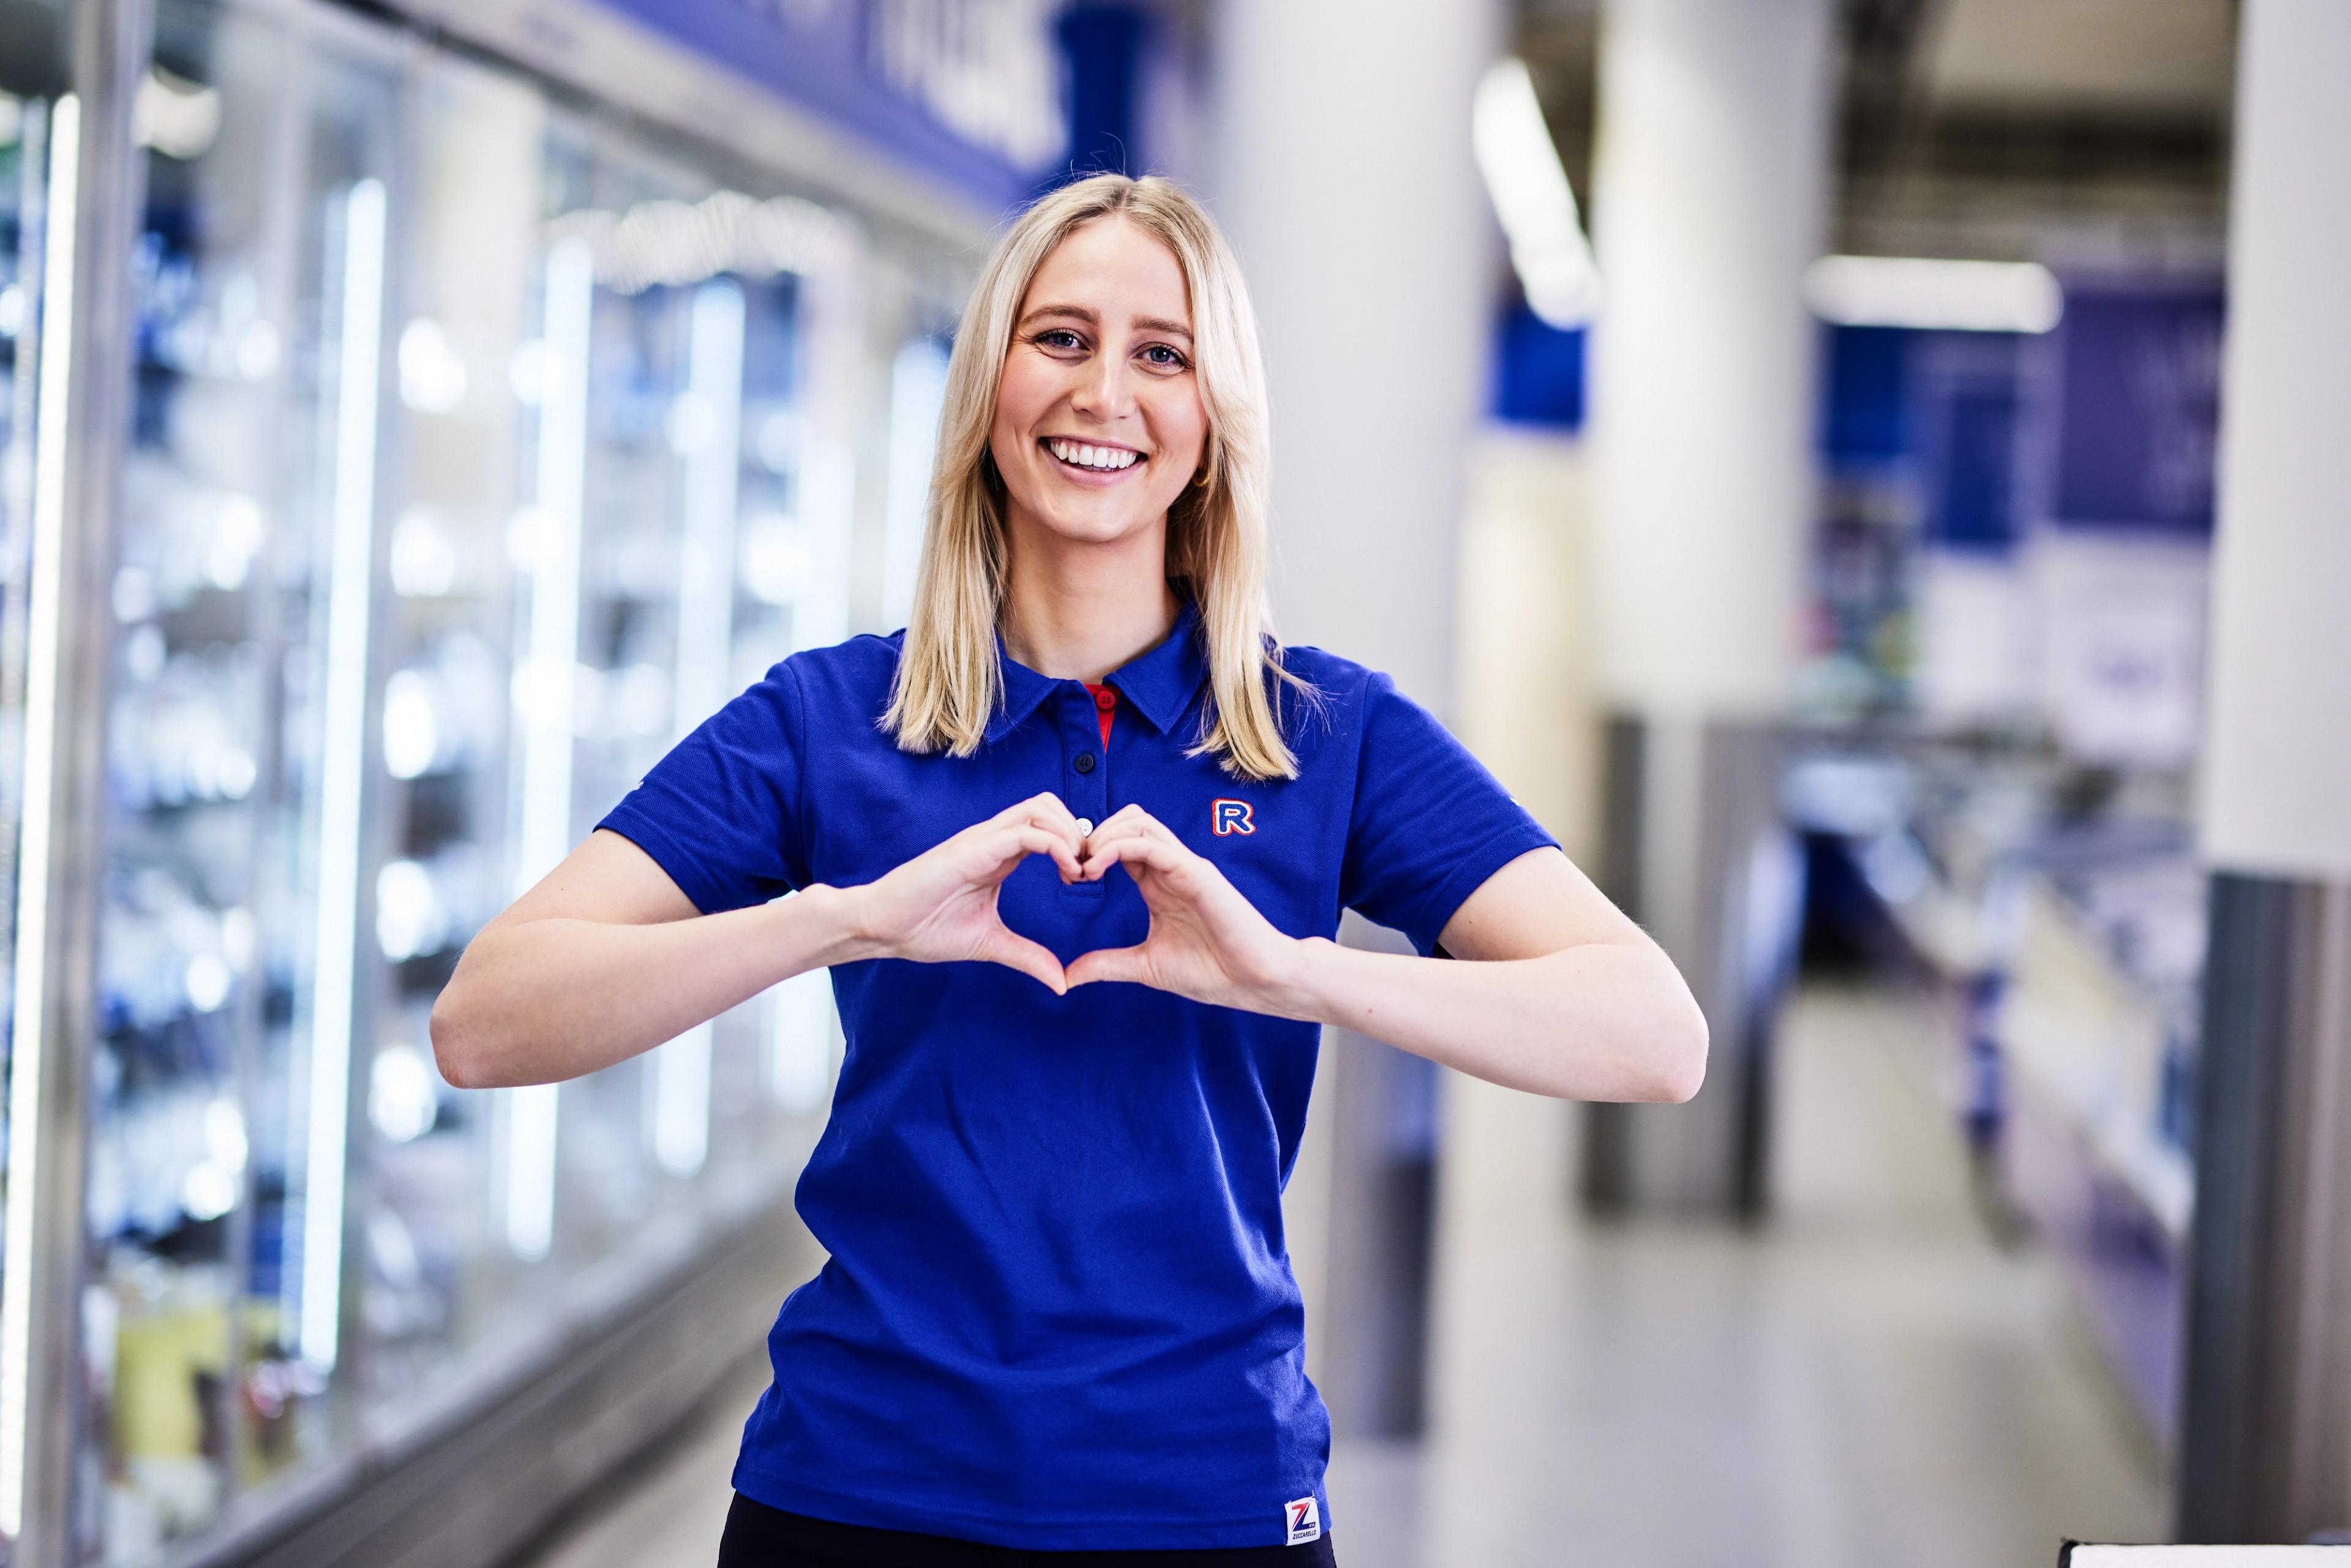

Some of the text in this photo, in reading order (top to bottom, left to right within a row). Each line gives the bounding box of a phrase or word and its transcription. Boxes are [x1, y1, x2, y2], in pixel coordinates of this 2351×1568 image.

[1212, 798, 1256, 836] R
[1292, 1502, 1316, 1532] Z
[1292, 1530, 1316, 1540] ZUCCARELLO
